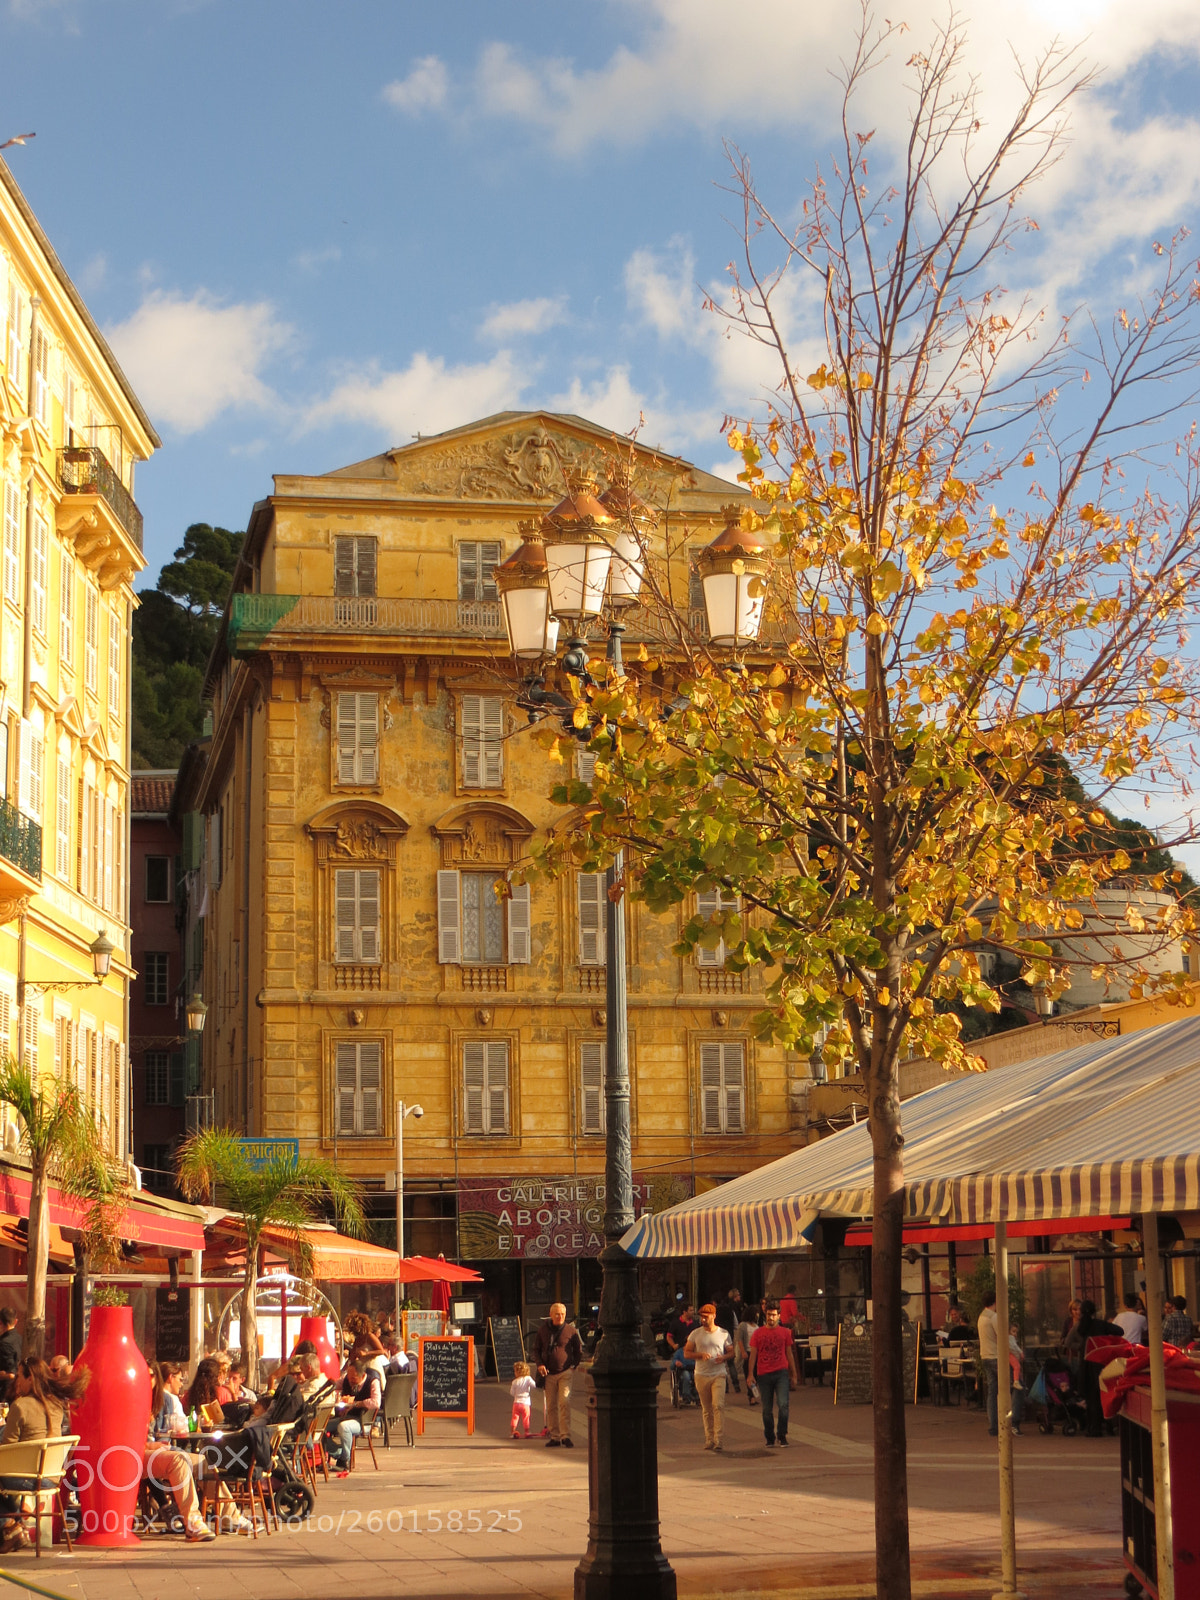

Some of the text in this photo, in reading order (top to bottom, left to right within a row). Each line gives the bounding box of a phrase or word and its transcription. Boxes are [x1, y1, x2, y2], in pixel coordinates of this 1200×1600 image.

[497, 1184, 655, 1202] GALERIE DRT
[497, 1207, 653, 1226] ABORIG
[498, 1229, 602, 1250] ET OCÉA
